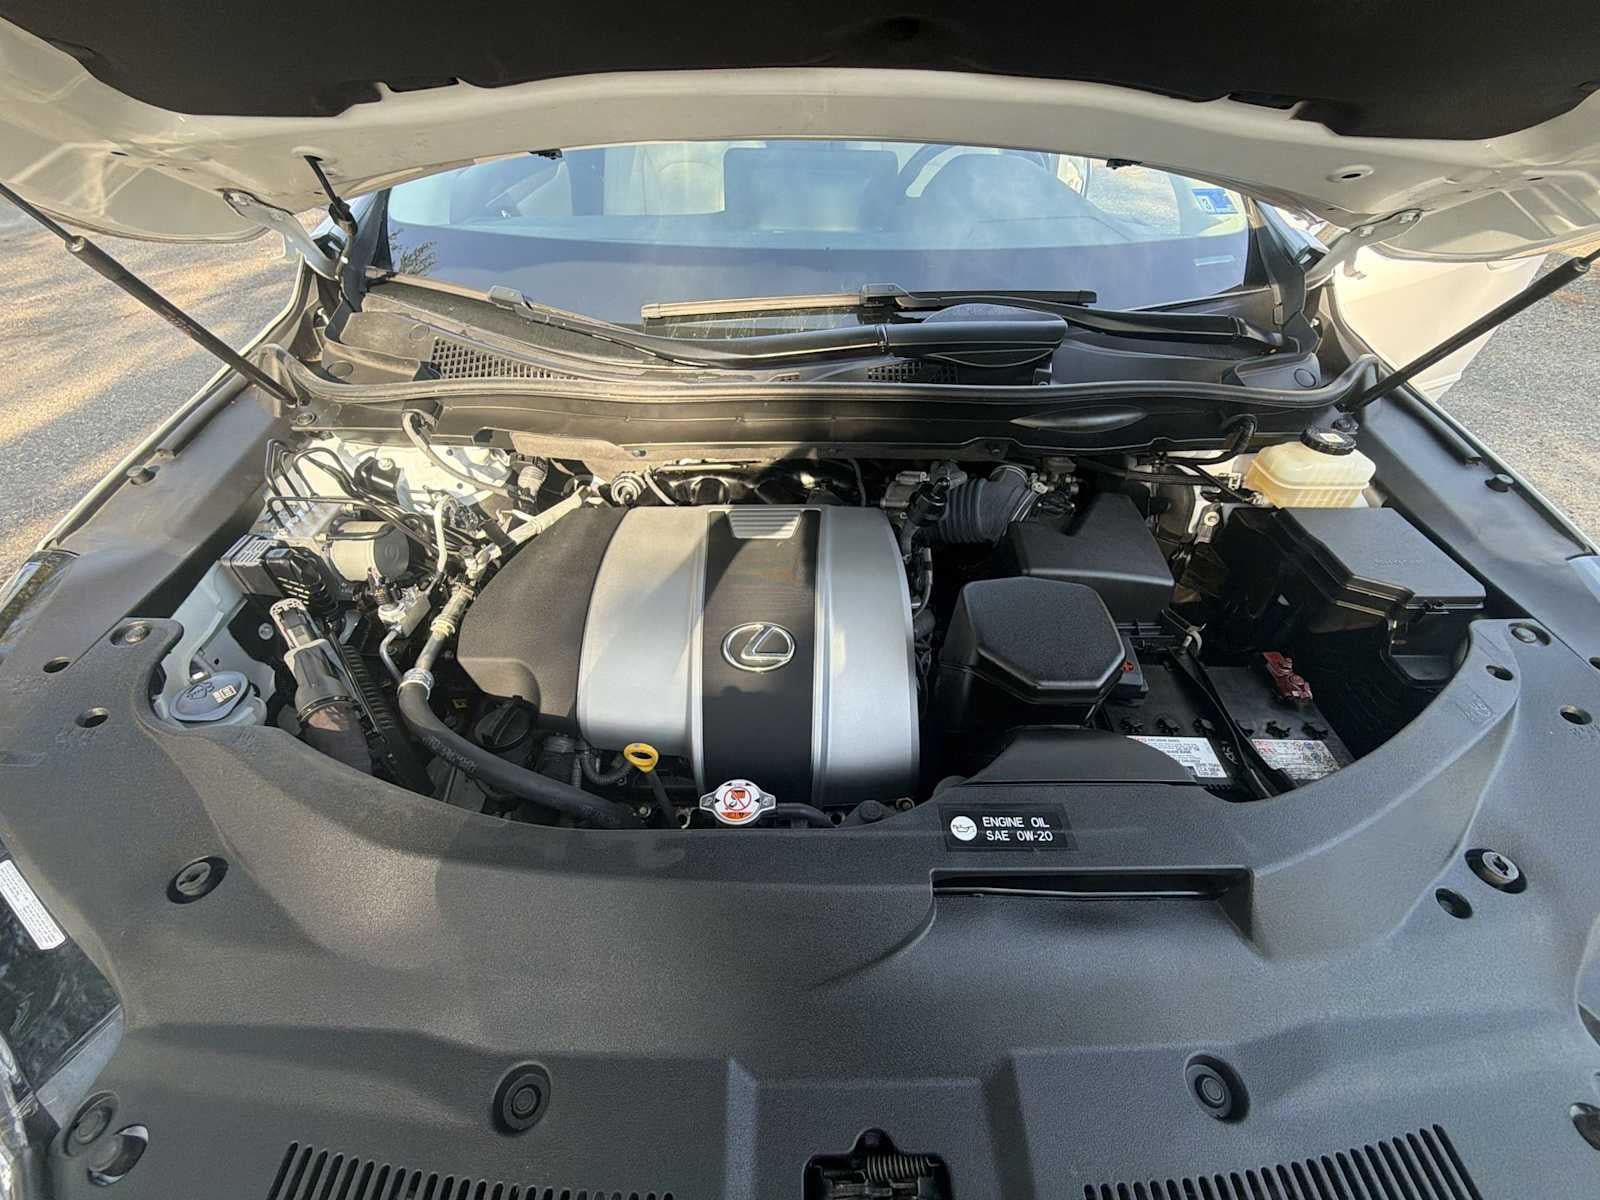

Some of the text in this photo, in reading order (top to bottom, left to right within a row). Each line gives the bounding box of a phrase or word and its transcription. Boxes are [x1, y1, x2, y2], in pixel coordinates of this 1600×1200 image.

[982, 816, 1050, 828] ENGINE OIL
[986, 829, 1053, 841] SAE 0W-20
